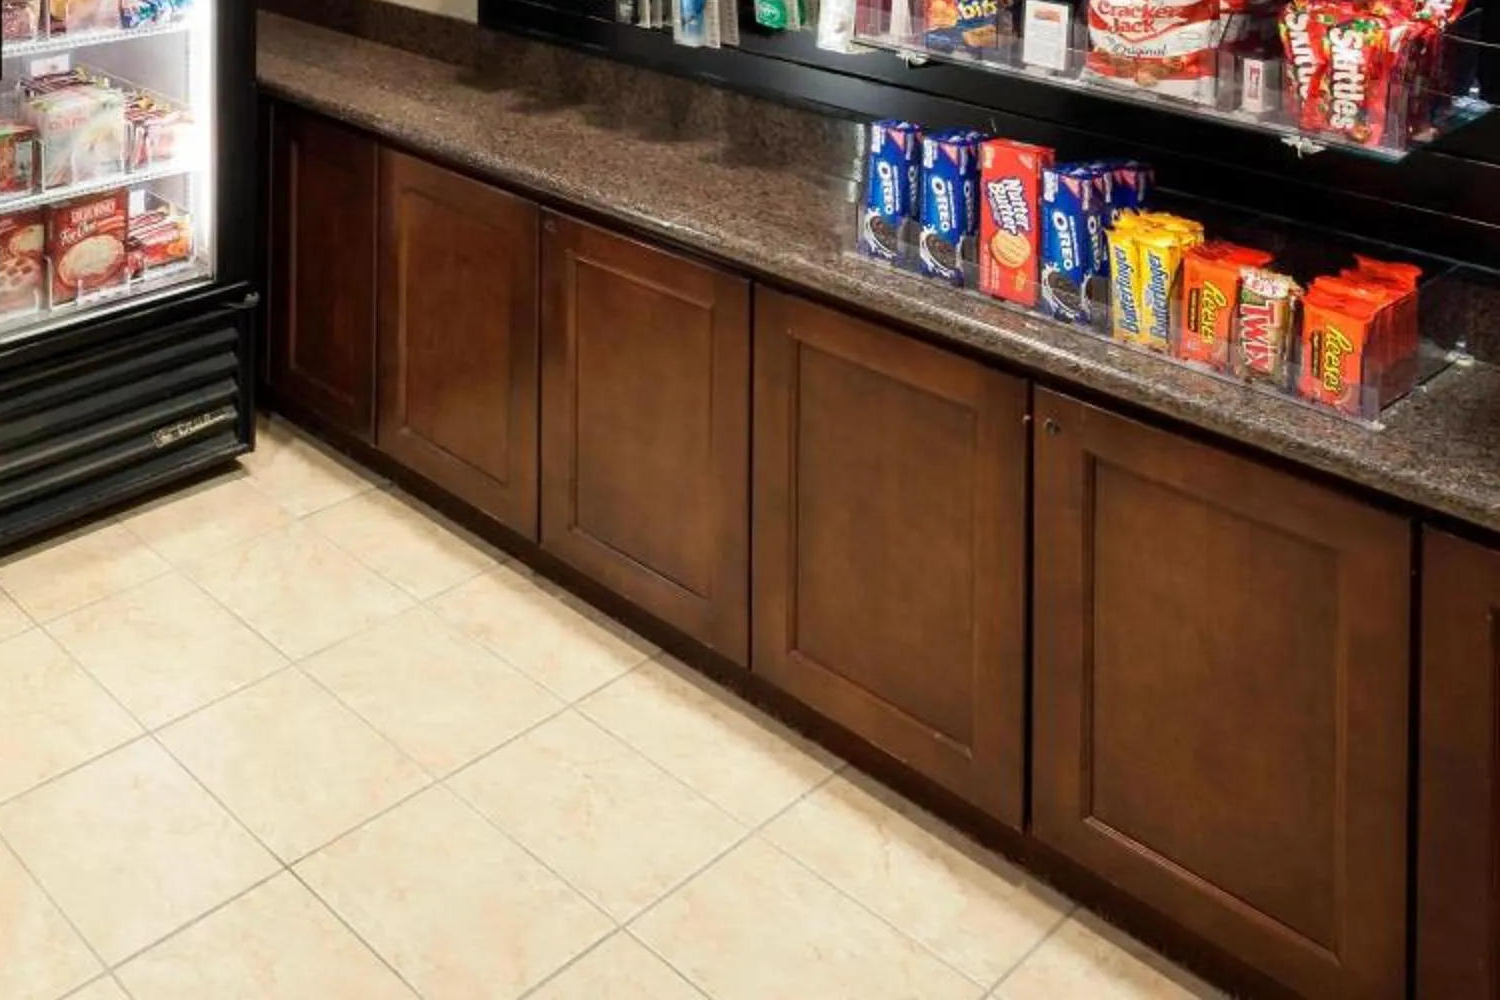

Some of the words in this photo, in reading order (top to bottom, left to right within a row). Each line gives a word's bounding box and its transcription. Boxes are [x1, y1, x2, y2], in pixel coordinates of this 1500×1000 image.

[958, 0, 997, 20] bits
[1109, 18, 1158, 34] Jack
[1329, 27, 1365, 130] Skittles
[877, 161, 895, 215] OREO
[931, 176, 951, 232] OREO
[988, 181, 1018, 236] Butter
[1002, 178, 1030, 231] Nutter
[1053, 211, 1073, 270] OREO
[1115, 244, 1140, 334] Butterfinger
[1148, 252, 1169, 338] Butterfinger
